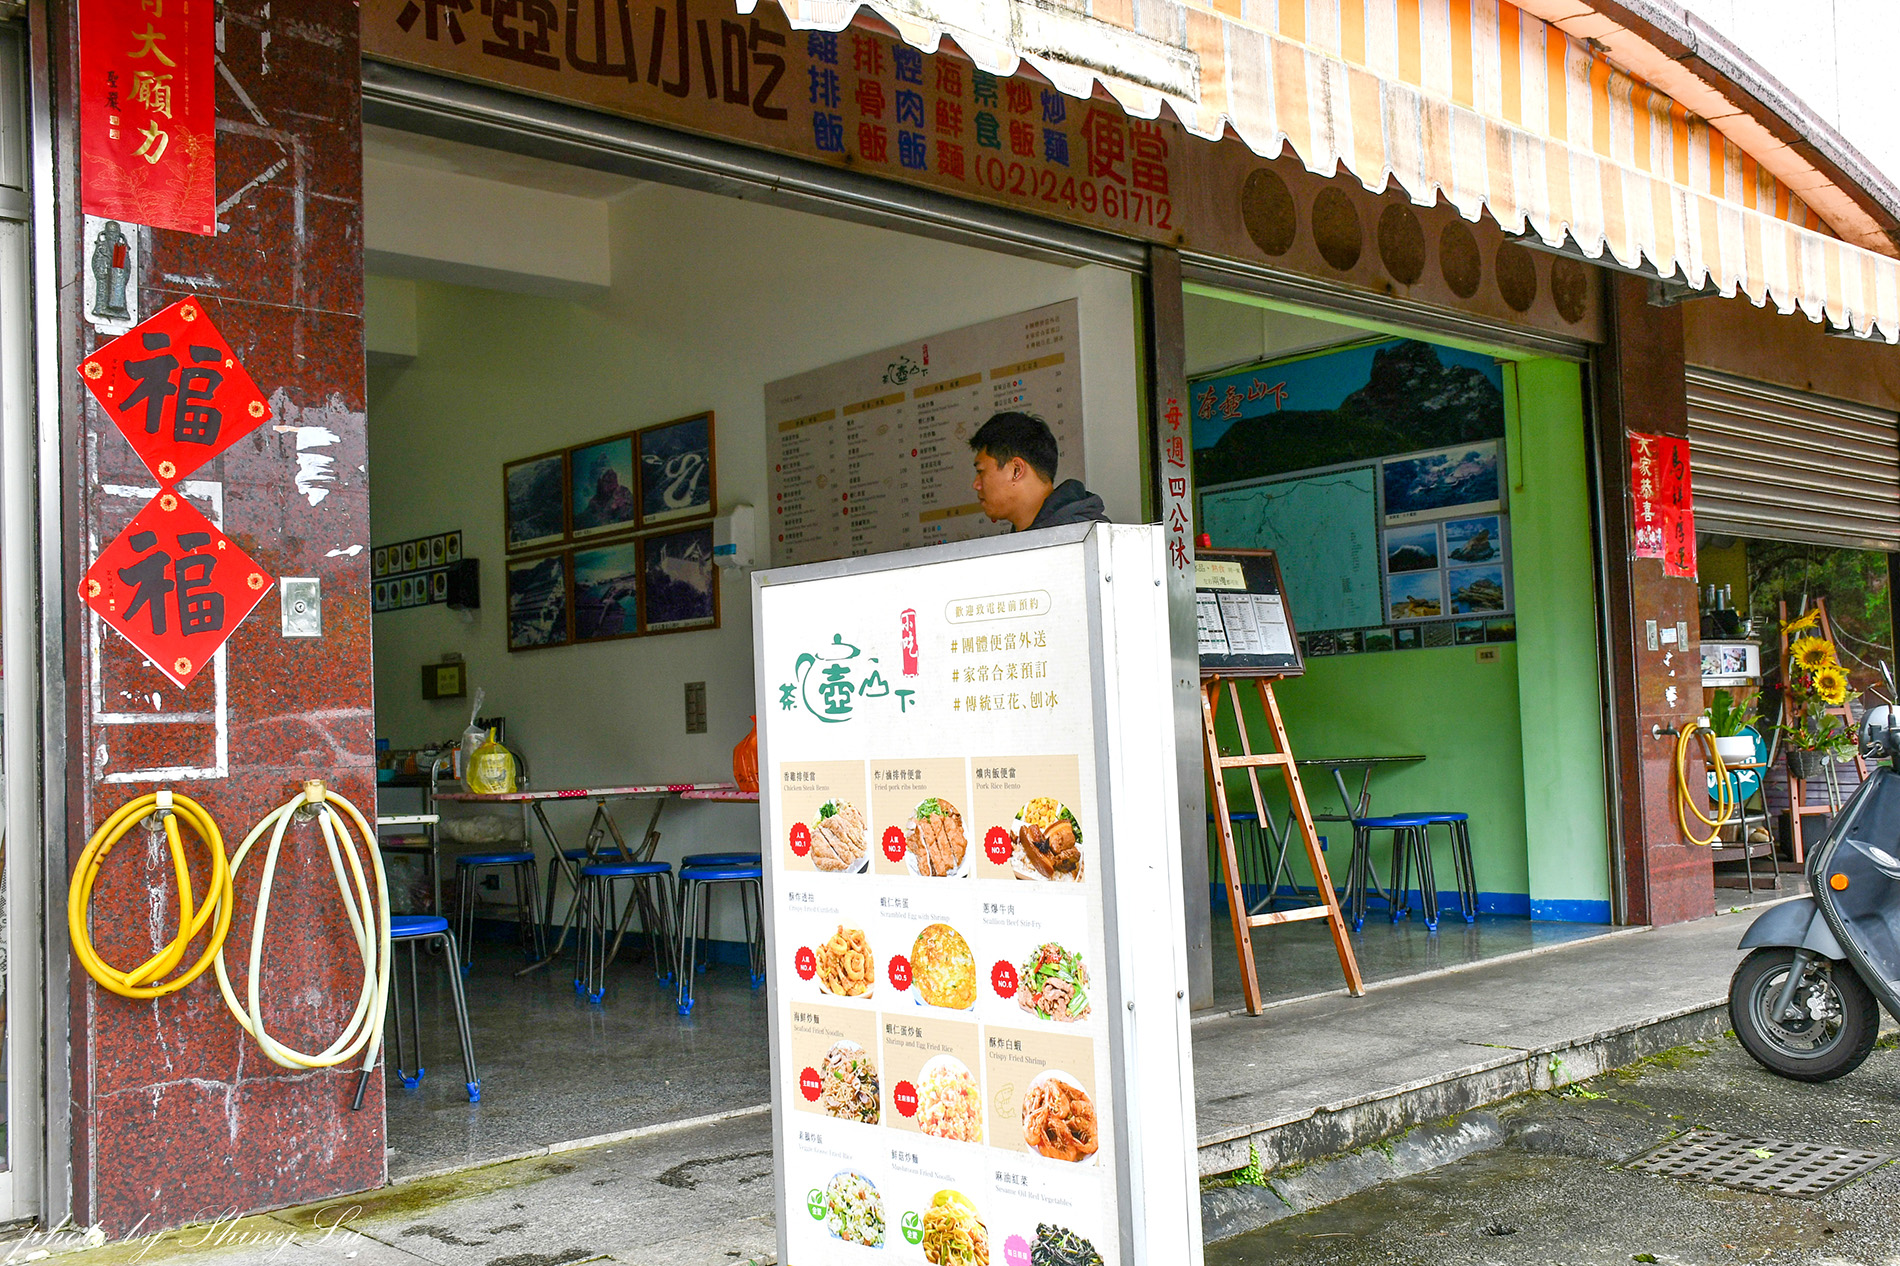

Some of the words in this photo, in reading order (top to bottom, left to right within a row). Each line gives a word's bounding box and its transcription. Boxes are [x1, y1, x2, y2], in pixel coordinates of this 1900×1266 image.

[852, 34, 889, 163] 排骨飯
[934, 57, 966, 182] 海鮮麵
[972, 68, 1001, 151] 素食
[1005, 78, 1036, 159] 炒飯
[1040, 88, 1070, 168] 炒麵
[1081, 105, 1169, 195] 便當
[974, 155, 1173, 231] (02)24961712
[118, 332, 225, 446] 福
[1197, 377, 1288, 421] 茶壺山下
[1164, 398, 1190, 570] 每週四公休
[1637, 438, 1655, 522] 大家恭喜
[118, 530, 226, 636] 福
[956, 598, 1039, 617] 歡迎致電提前預約
[779, 648, 915, 719] 茶壺山下
[888, 784, 900, 792] pork
[888, 845, 901, 853] NO.2
[991, 846, 1006, 854] NO.3
[800, 964, 812, 972] NO.4
[894, 973, 907, 982] NO.5
[998, 980, 1013, 989] NO.6
[886, 1037, 904, 1047] Shrimp
[927, 1043, 940, 1051] Fried
[989, 1051, 1006, 1061] Crispy
[1008, 1054, 1023, 1063] Fried
[1025, 1056, 1046, 1067] Shrimp
